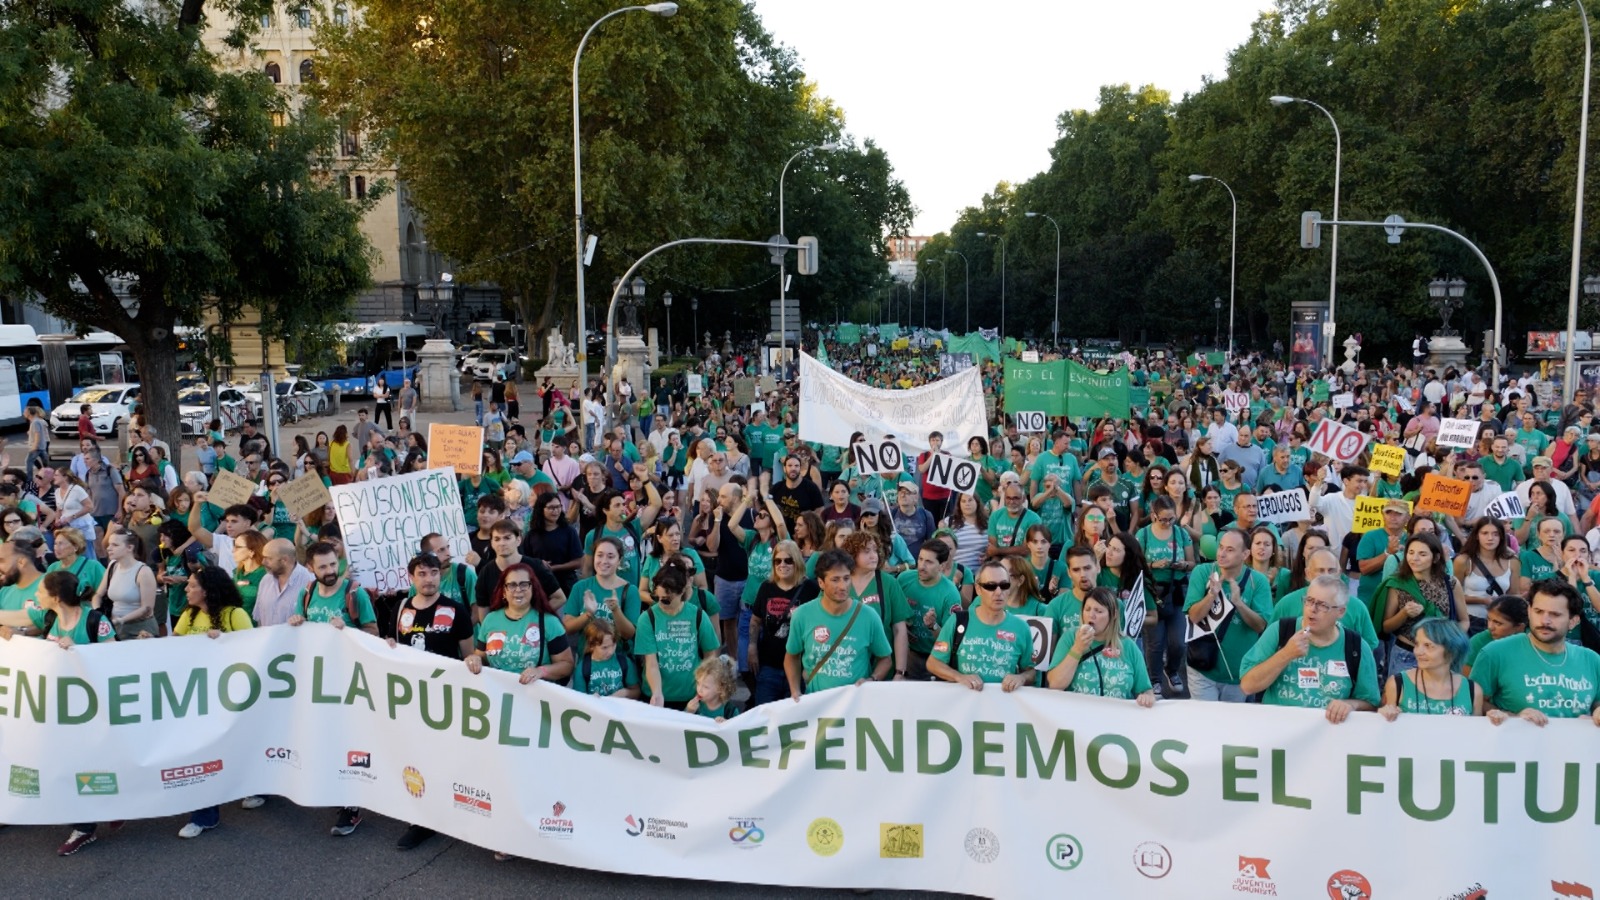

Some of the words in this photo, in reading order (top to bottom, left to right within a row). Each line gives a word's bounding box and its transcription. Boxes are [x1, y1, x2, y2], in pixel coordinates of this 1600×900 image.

[1225, 393, 1249, 408] NO
[1017, 412, 1044, 430] NO
[1310, 420, 1364, 461] NO
[856, 441, 901, 474] NO
[929, 454, 977, 492] NO
[337, 484, 401, 521] AYUSO
[400, 472, 461, 513] NUESTRA
[1505, 495, 1523, 516] NO
[443, 507, 467, 537] NO
[349, 547, 377, 573] ES
[379, 544, 400, 569] UN
[311, 656, 376, 712] LA
[387, 668, 661, 764] PÚBLICA.
[684, 717, 1190, 797] DEFENDEMOS
[1222, 744, 1312, 810] EL
[1347, 754, 1600, 825] FUTU
[265, 747, 291, 759] CGT
[351, 754, 369, 765] CNT
[163, 764, 204, 780] CCOO
[453, 782, 492, 801] CONFAPA
[540, 817, 574, 827] CONTRA
[736, 821, 757, 829] TEA
[1232, 884, 1278, 896] COMUNISTA
[1233, 877, 1276, 889] JUVENTUD
